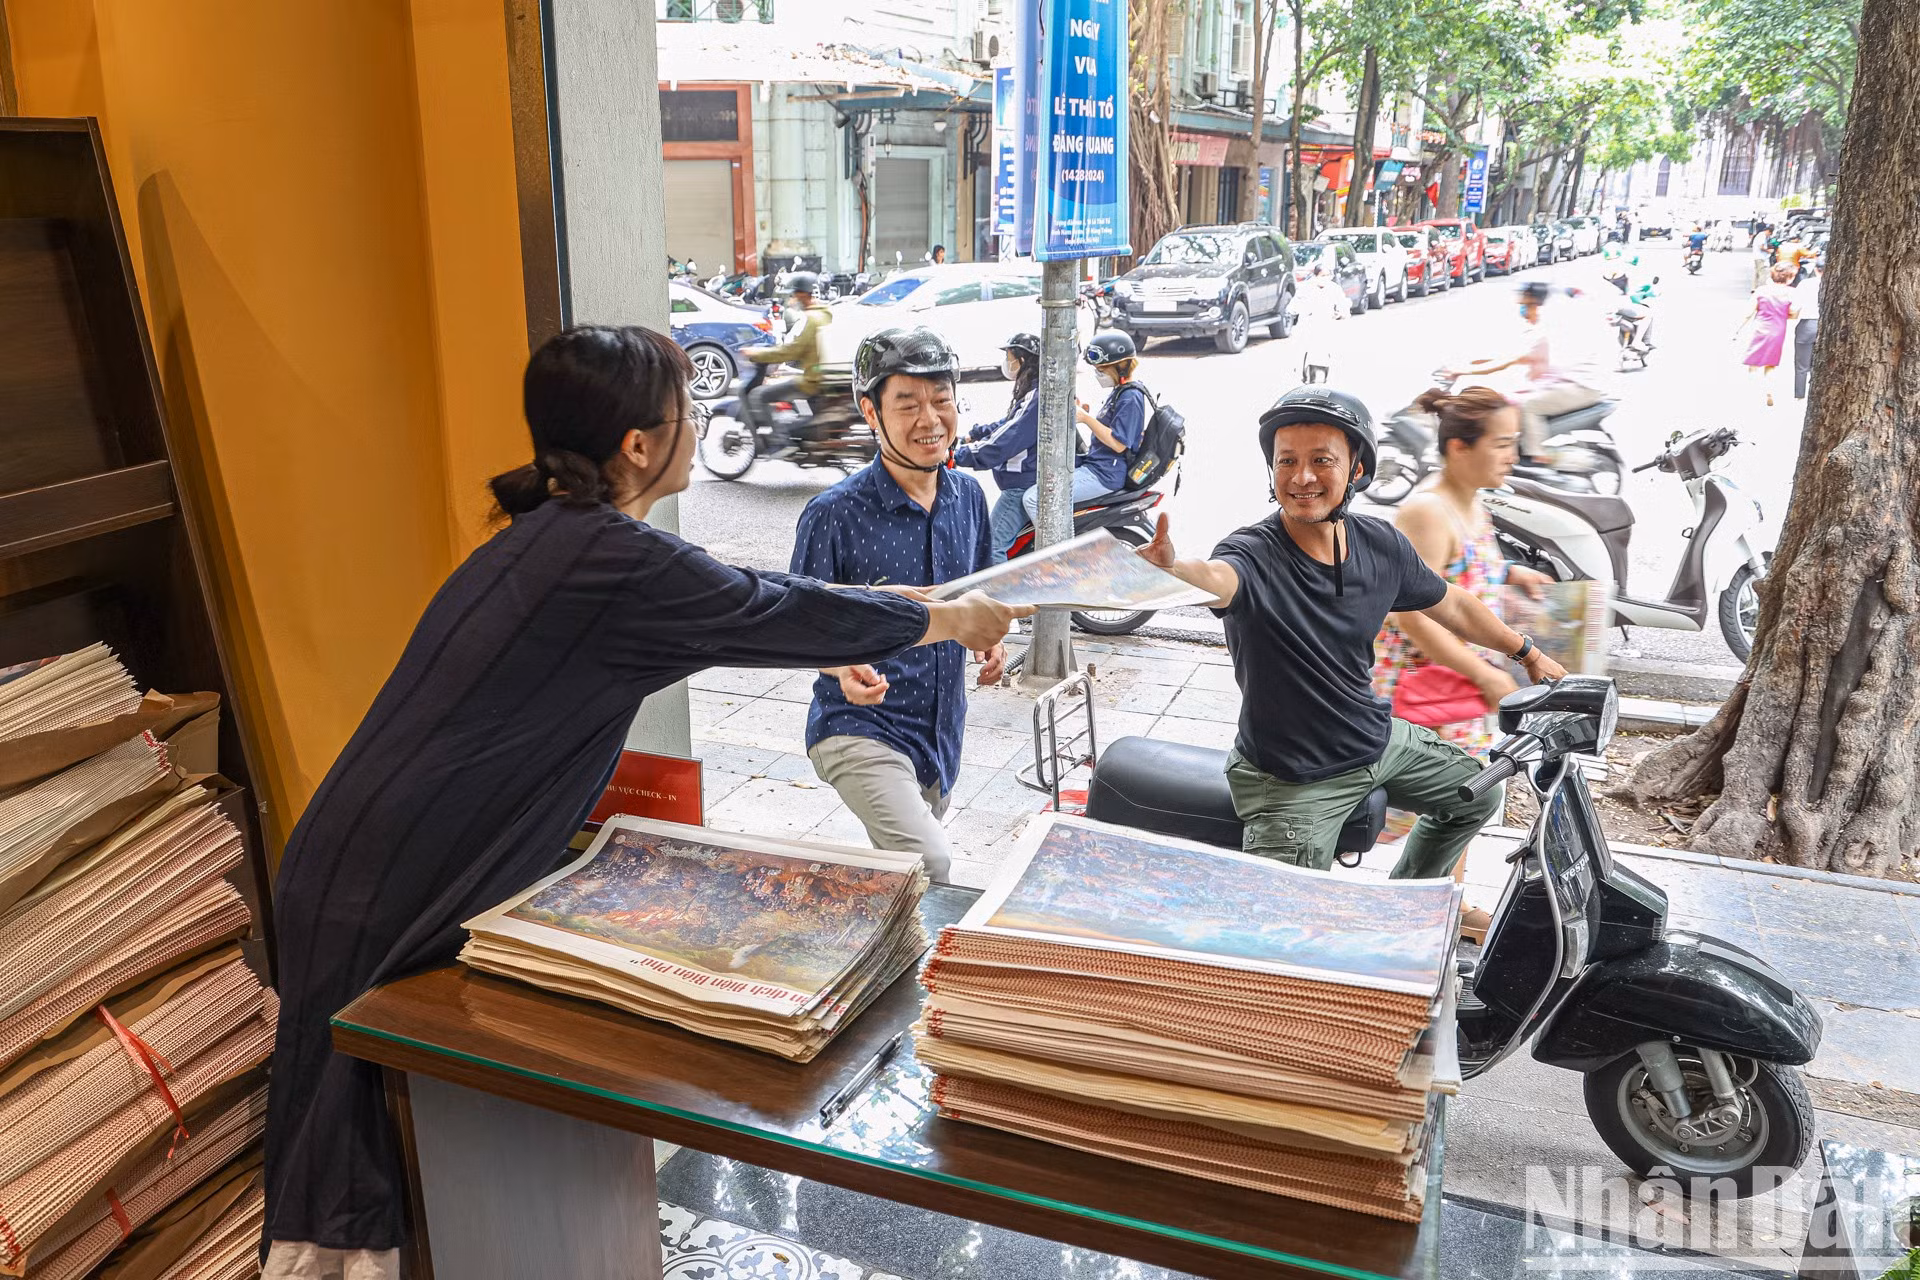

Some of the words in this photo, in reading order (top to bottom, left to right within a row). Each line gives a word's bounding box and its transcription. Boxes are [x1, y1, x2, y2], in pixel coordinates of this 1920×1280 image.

[1053, 130, 1083, 153] ĐĂNG
[636, 788, 662, 800] CHECK
[673, 965, 711, 986] Biên
[709, 977, 750, 994] Điện
[749, 984, 787, 1001] dịch
